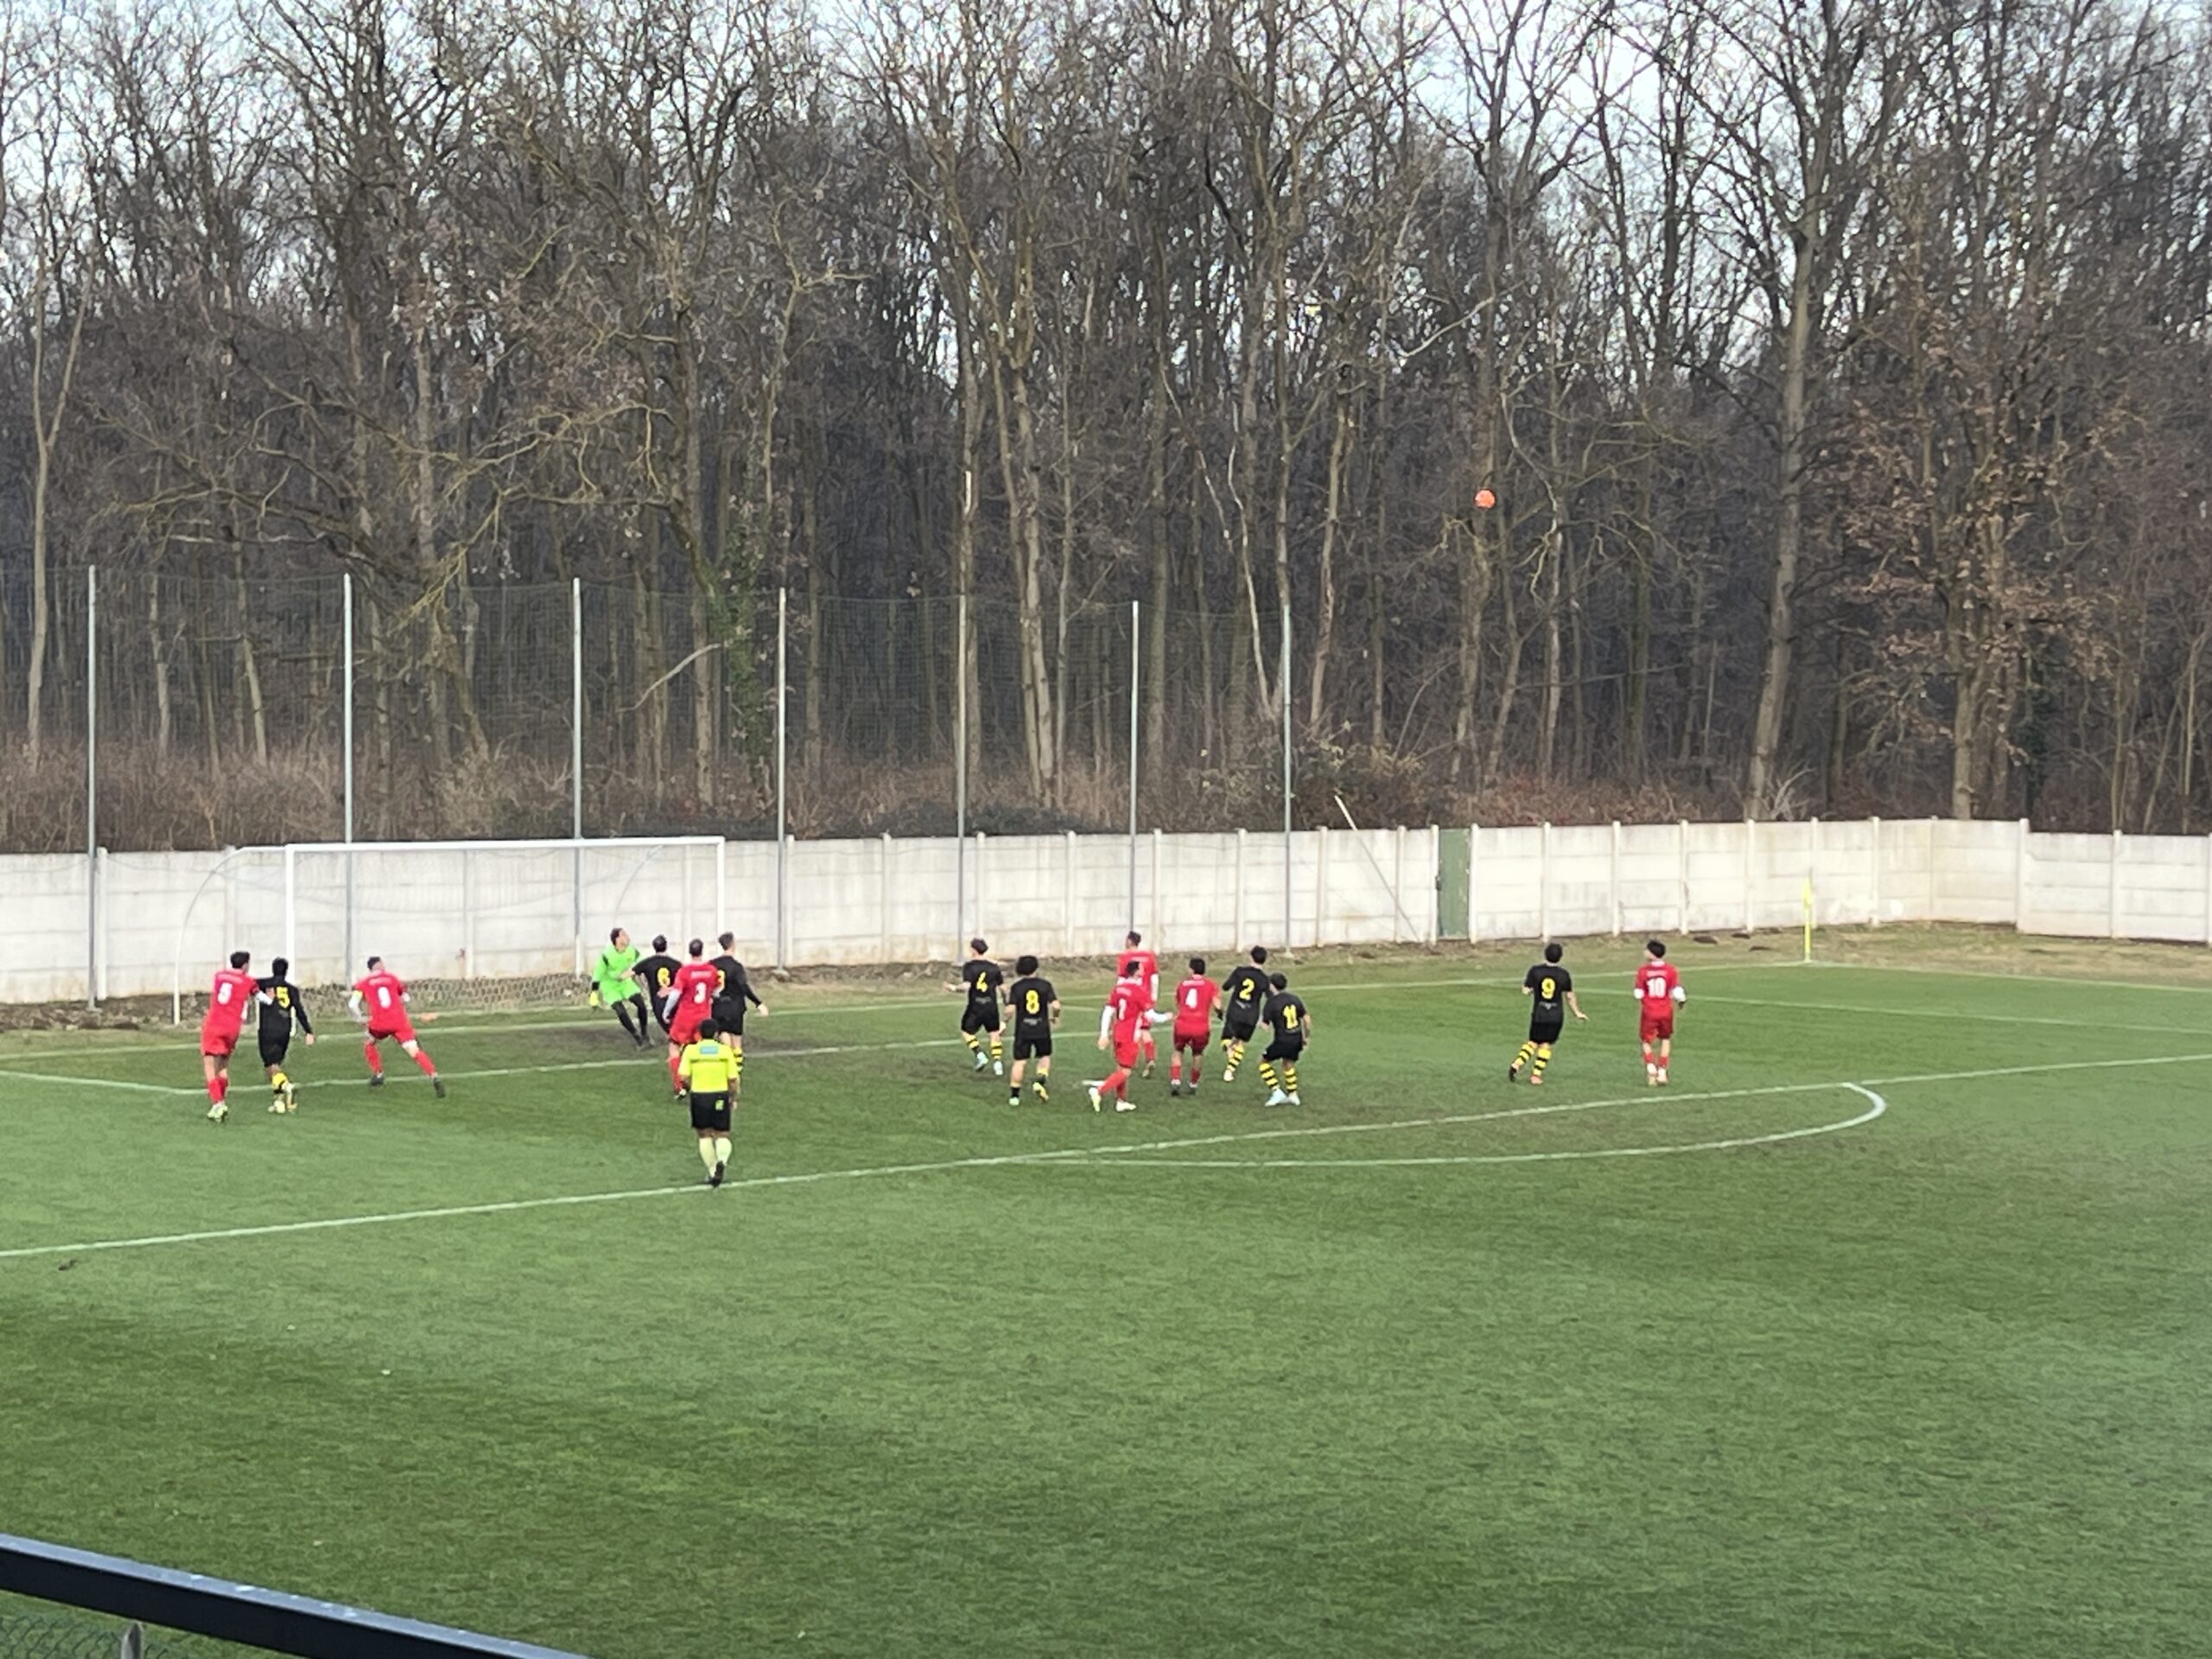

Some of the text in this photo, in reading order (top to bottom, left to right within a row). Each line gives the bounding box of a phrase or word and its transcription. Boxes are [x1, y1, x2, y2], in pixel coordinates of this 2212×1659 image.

[694, 982, 707, 1004] 3
[976, 971, 988, 993] 4
[1238, 978, 1255, 1001] 2
[1541, 977, 1556, 1000] 9
[1645, 977, 1667, 999] 10
[1025, 989, 1040, 1014] 8
[1185, 988, 1198, 1009] 4
[1282, 1003, 1299, 1029] 11
